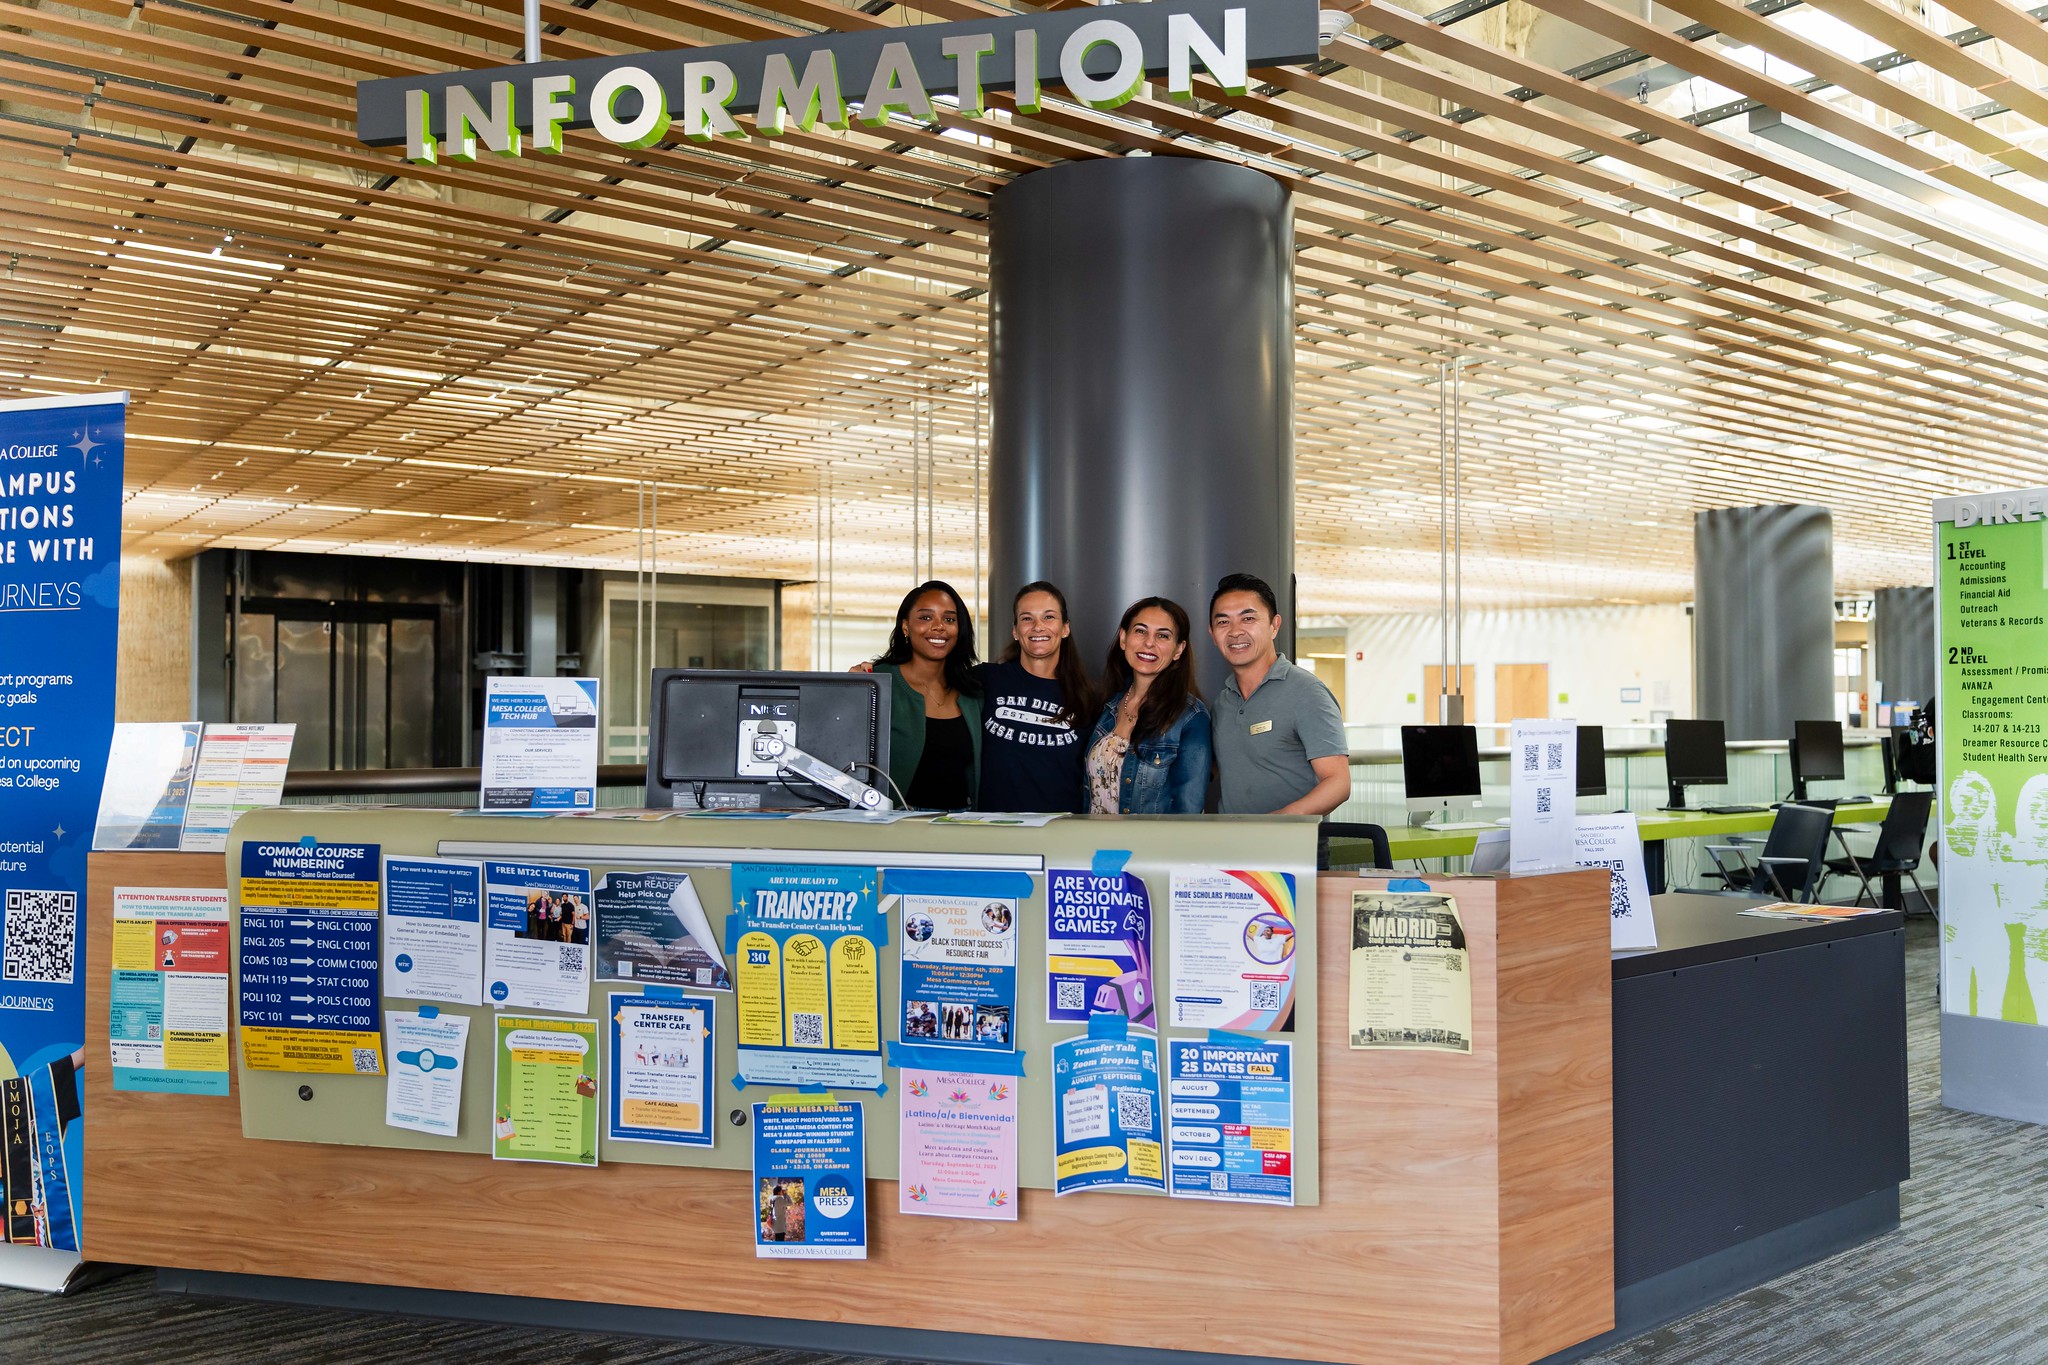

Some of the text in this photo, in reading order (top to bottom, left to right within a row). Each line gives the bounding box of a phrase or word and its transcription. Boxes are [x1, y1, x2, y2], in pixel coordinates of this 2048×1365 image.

[405, 8, 1247, 164] INFORMATION
[10, 445, 58, 459] COLLEGE
[1954, 496, 2048, 528] DIRE
[28, 537, 94, 563] WITH
[1947, 542, 1970, 560] 1 ST
[1960, 550, 1986, 559] LEVEL
[1960, 561, 2006, 571] Accounting
[1960, 576, 2006, 585] Admissions
[1960, 589, 2010, 599] Financial Aid
[1960, 604, 1998, 613] Outreach
[1961, 616, 2043, 627] Veterans & Records
[1949, 647, 1973, 664] 2 ND
[1961, 655, 1988, 664] LEVEL
[1962, 667, 2012, 676] Assessment
[16, 674, 73, 688] programs
[1962, 682, 1993, 690] AVANZA
[7, 691, 37, 707] goals
[997, 696, 1027, 706] SAN
[1972, 696, 2023, 706] Engagement
[1002, 710, 1028, 720] EST.
[1962, 710, 2012, 719] Classrooms:
[985, 717, 1078, 746] MESA COLLEGE
[1973, 724, 2040, 733] 14-207 & 14-213
[1963, 739, 2040, 748] Dreamer Resource
[1963, 753, 1995, 762] Student
[1998, 753, 2024, 762] Health
[8, 757, 80, 773] on upcoming
[16, 775, 60, 791] College
[258, 846, 364, 858] COMMON COURSE
[273, 858, 344, 869] NUMBERING
[496, 866, 580, 882] FREE MT2C Tutoring
[616, 880, 641, 889] STEM
[1054, 877, 1123, 891] ARE YOU
[756, 890, 858, 921] TRANSFER?
[1054, 891, 1143, 909] PASSIONATE
[928, 907, 967, 915] ROOTED
[1054, 905, 1110, 919] ABOUT
[243, 919, 372, 931] ENGL 101 ENGL C1000
[1054, 920, 1117, 934] GAMES?
[1369, 918, 1438, 939] MADRID
[954, 928, 986, 937] RISING
[243, 937, 370, 950] ENGL 205 ENGL C1001
[932, 938, 1002, 948] BLACK STUDENT SUCCESS
[751, 952, 766, 962] 30
[946, 950, 975, 958] RESOURCE
[243, 955, 378, 969] COMS 103 COMM C1000
[243, 974, 369, 988] MATH 119 STAT C1000
[0, 996, 54, 1010] JOURNEYS
[243, 992, 370, 1007] POLI 102 POLS C1000
[243, 1011, 370, 1025] PSYC 101 PSYC C1000
[641, 1014, 685, 1022] TRANSFER
[634, 1020, 667, 1029] CENTER
[1075, 1043, 1136, 1056] Transfer Talk
[1180, 1049, 1279, 1063] 20 IMPORTANT
[1072, 1057, 1139, 1070] Zoom Drop ins
[1181, 1062, 1199, 1072] 25
[1204, 1063, 1245, 1073] DATES
[957, 1077, 986, 1085] COLLEGE
[1071, 1073, 1142, 1085] AUGUST SEPTEMBER
[10, 1081, 22, 1144] UMOJA
[959, 1113, 1014, 1122] Bienvenida!
[45, 1132, 57, 1180] EOPS
[820, 1188, 847, 1196] MESA
[819, 1197, 848, 1206] PRESS
